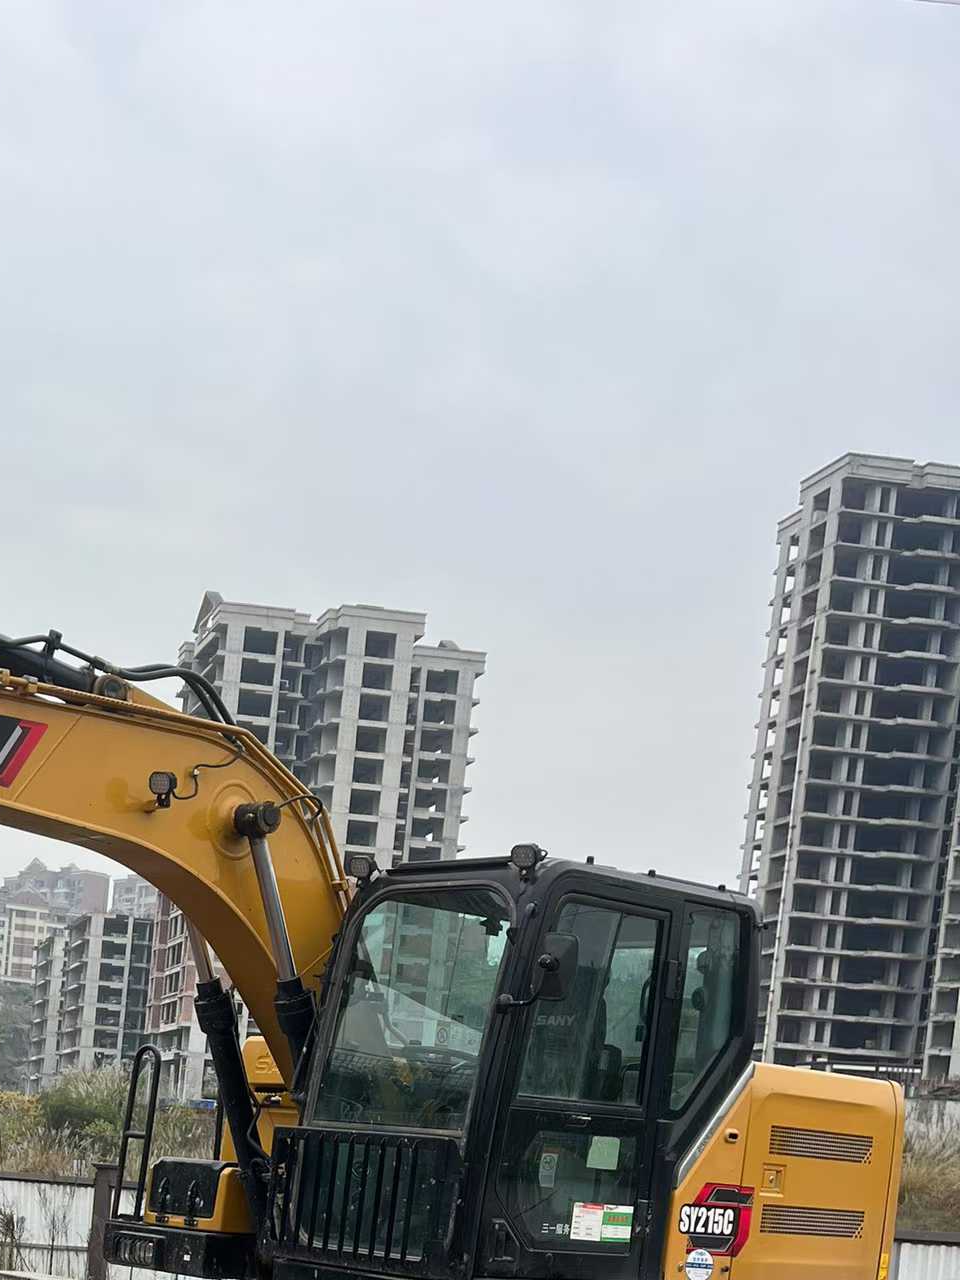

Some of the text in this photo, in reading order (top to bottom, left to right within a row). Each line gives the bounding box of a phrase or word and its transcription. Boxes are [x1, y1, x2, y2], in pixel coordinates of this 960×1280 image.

[536, 1015, 576, 1027] SANY
[680, 1205, 734, 1236] SY215C
[541, 1223, 571, 1235] 三一服务
